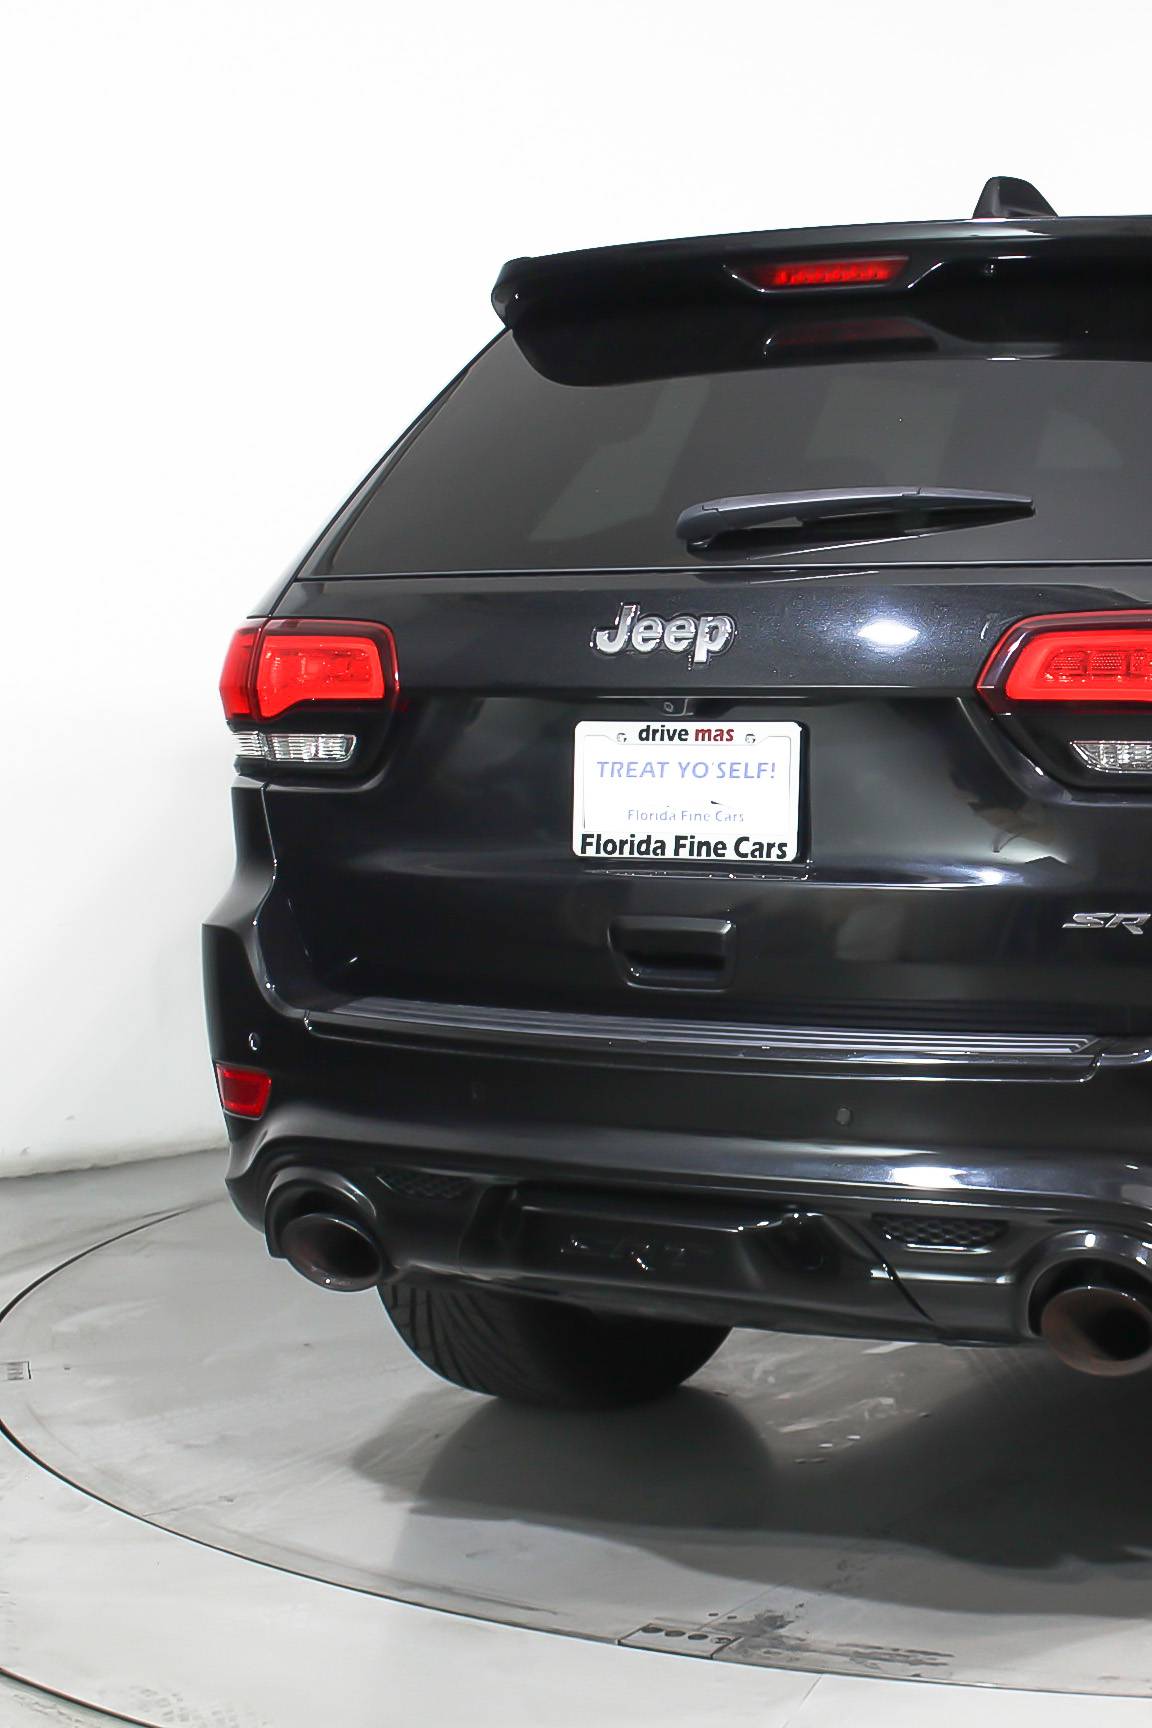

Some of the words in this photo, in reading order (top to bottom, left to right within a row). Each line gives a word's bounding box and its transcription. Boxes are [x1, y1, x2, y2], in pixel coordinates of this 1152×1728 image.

[592, 602, 736, 666] Jeep
[638, 725, 690, 742] drive
[694, 728, 735, 742] mas
[597, 760, 670, 779] TREAT
[627, 808, 676, 823] Florida
[681, 809, 711, 823] Fine
[716, 810, 745, 823] Cars
[580, 833, 667, 857] Florida
[673, 835, 728, 859] Fine
[733, 836, 788, 861] Cars
